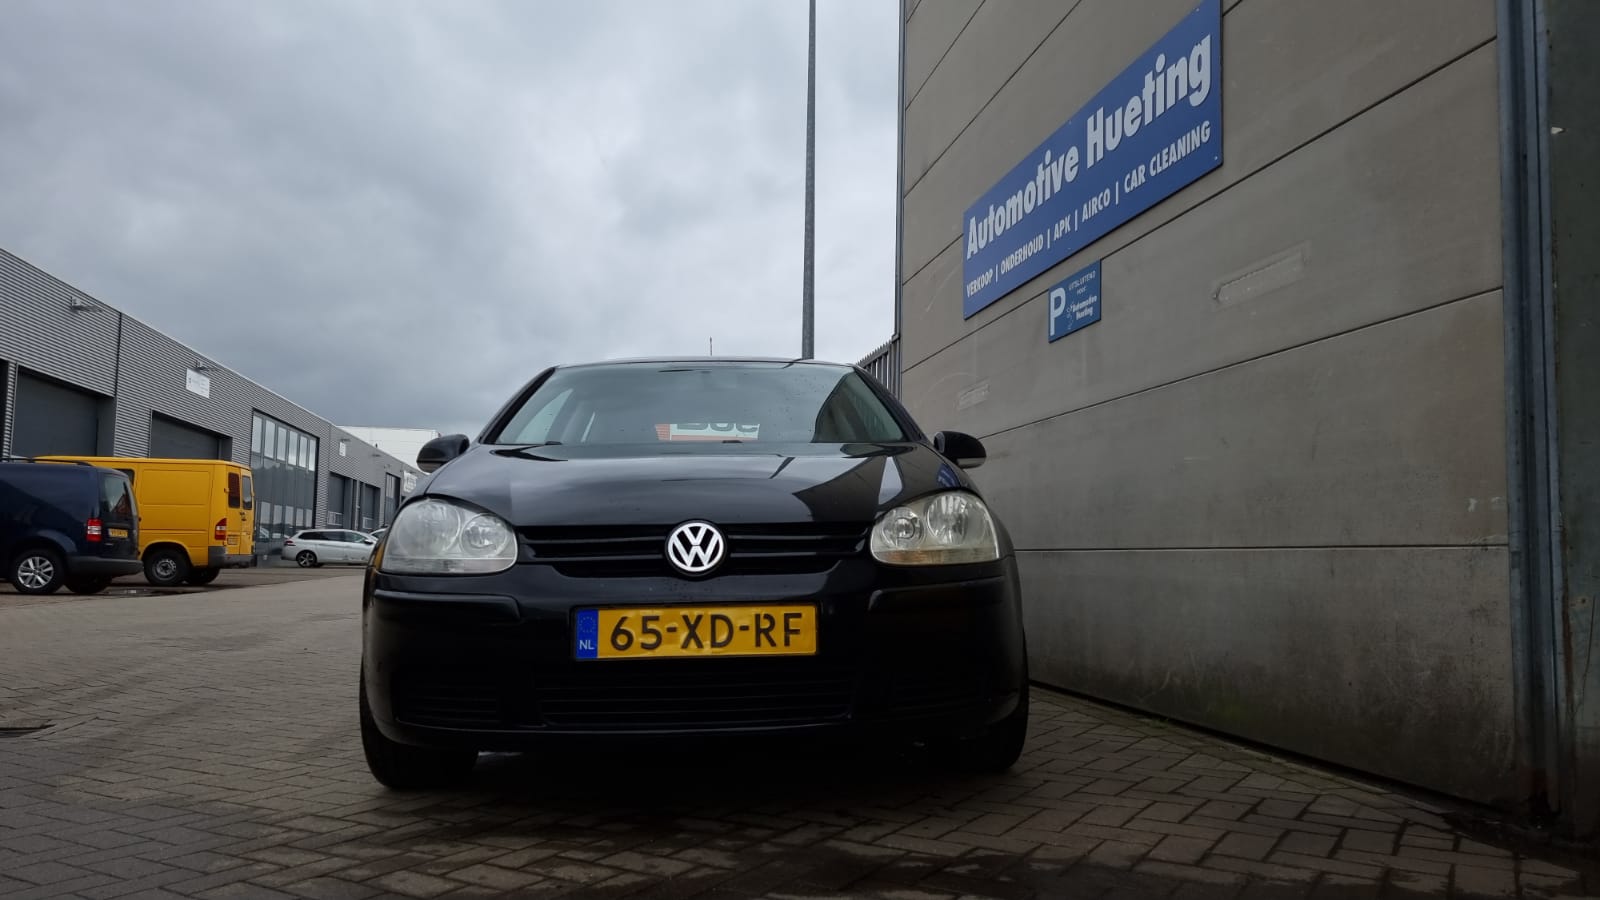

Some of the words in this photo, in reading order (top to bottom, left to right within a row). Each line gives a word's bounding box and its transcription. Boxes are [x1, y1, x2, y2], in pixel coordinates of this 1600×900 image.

[966, 145, 1079, 261] Automotive
[1086, 34, 1212, 169] Hueting
[966, 268, 994, 298] VERKOOP
[1000, 234, 1044, 275] ONDERHOUD
[1053, 215, 1071, 241] APK
[1081, 187, 1111, 223] AIRCO
[1123, 163, 1146, 194] CAR
[1149, 120, 1211, 177] CLEANING
[1049, 287, 1066, 337] P
[579, 639, 595, 650] NL
[609, 612, 803, 651] 65-XD-RF
